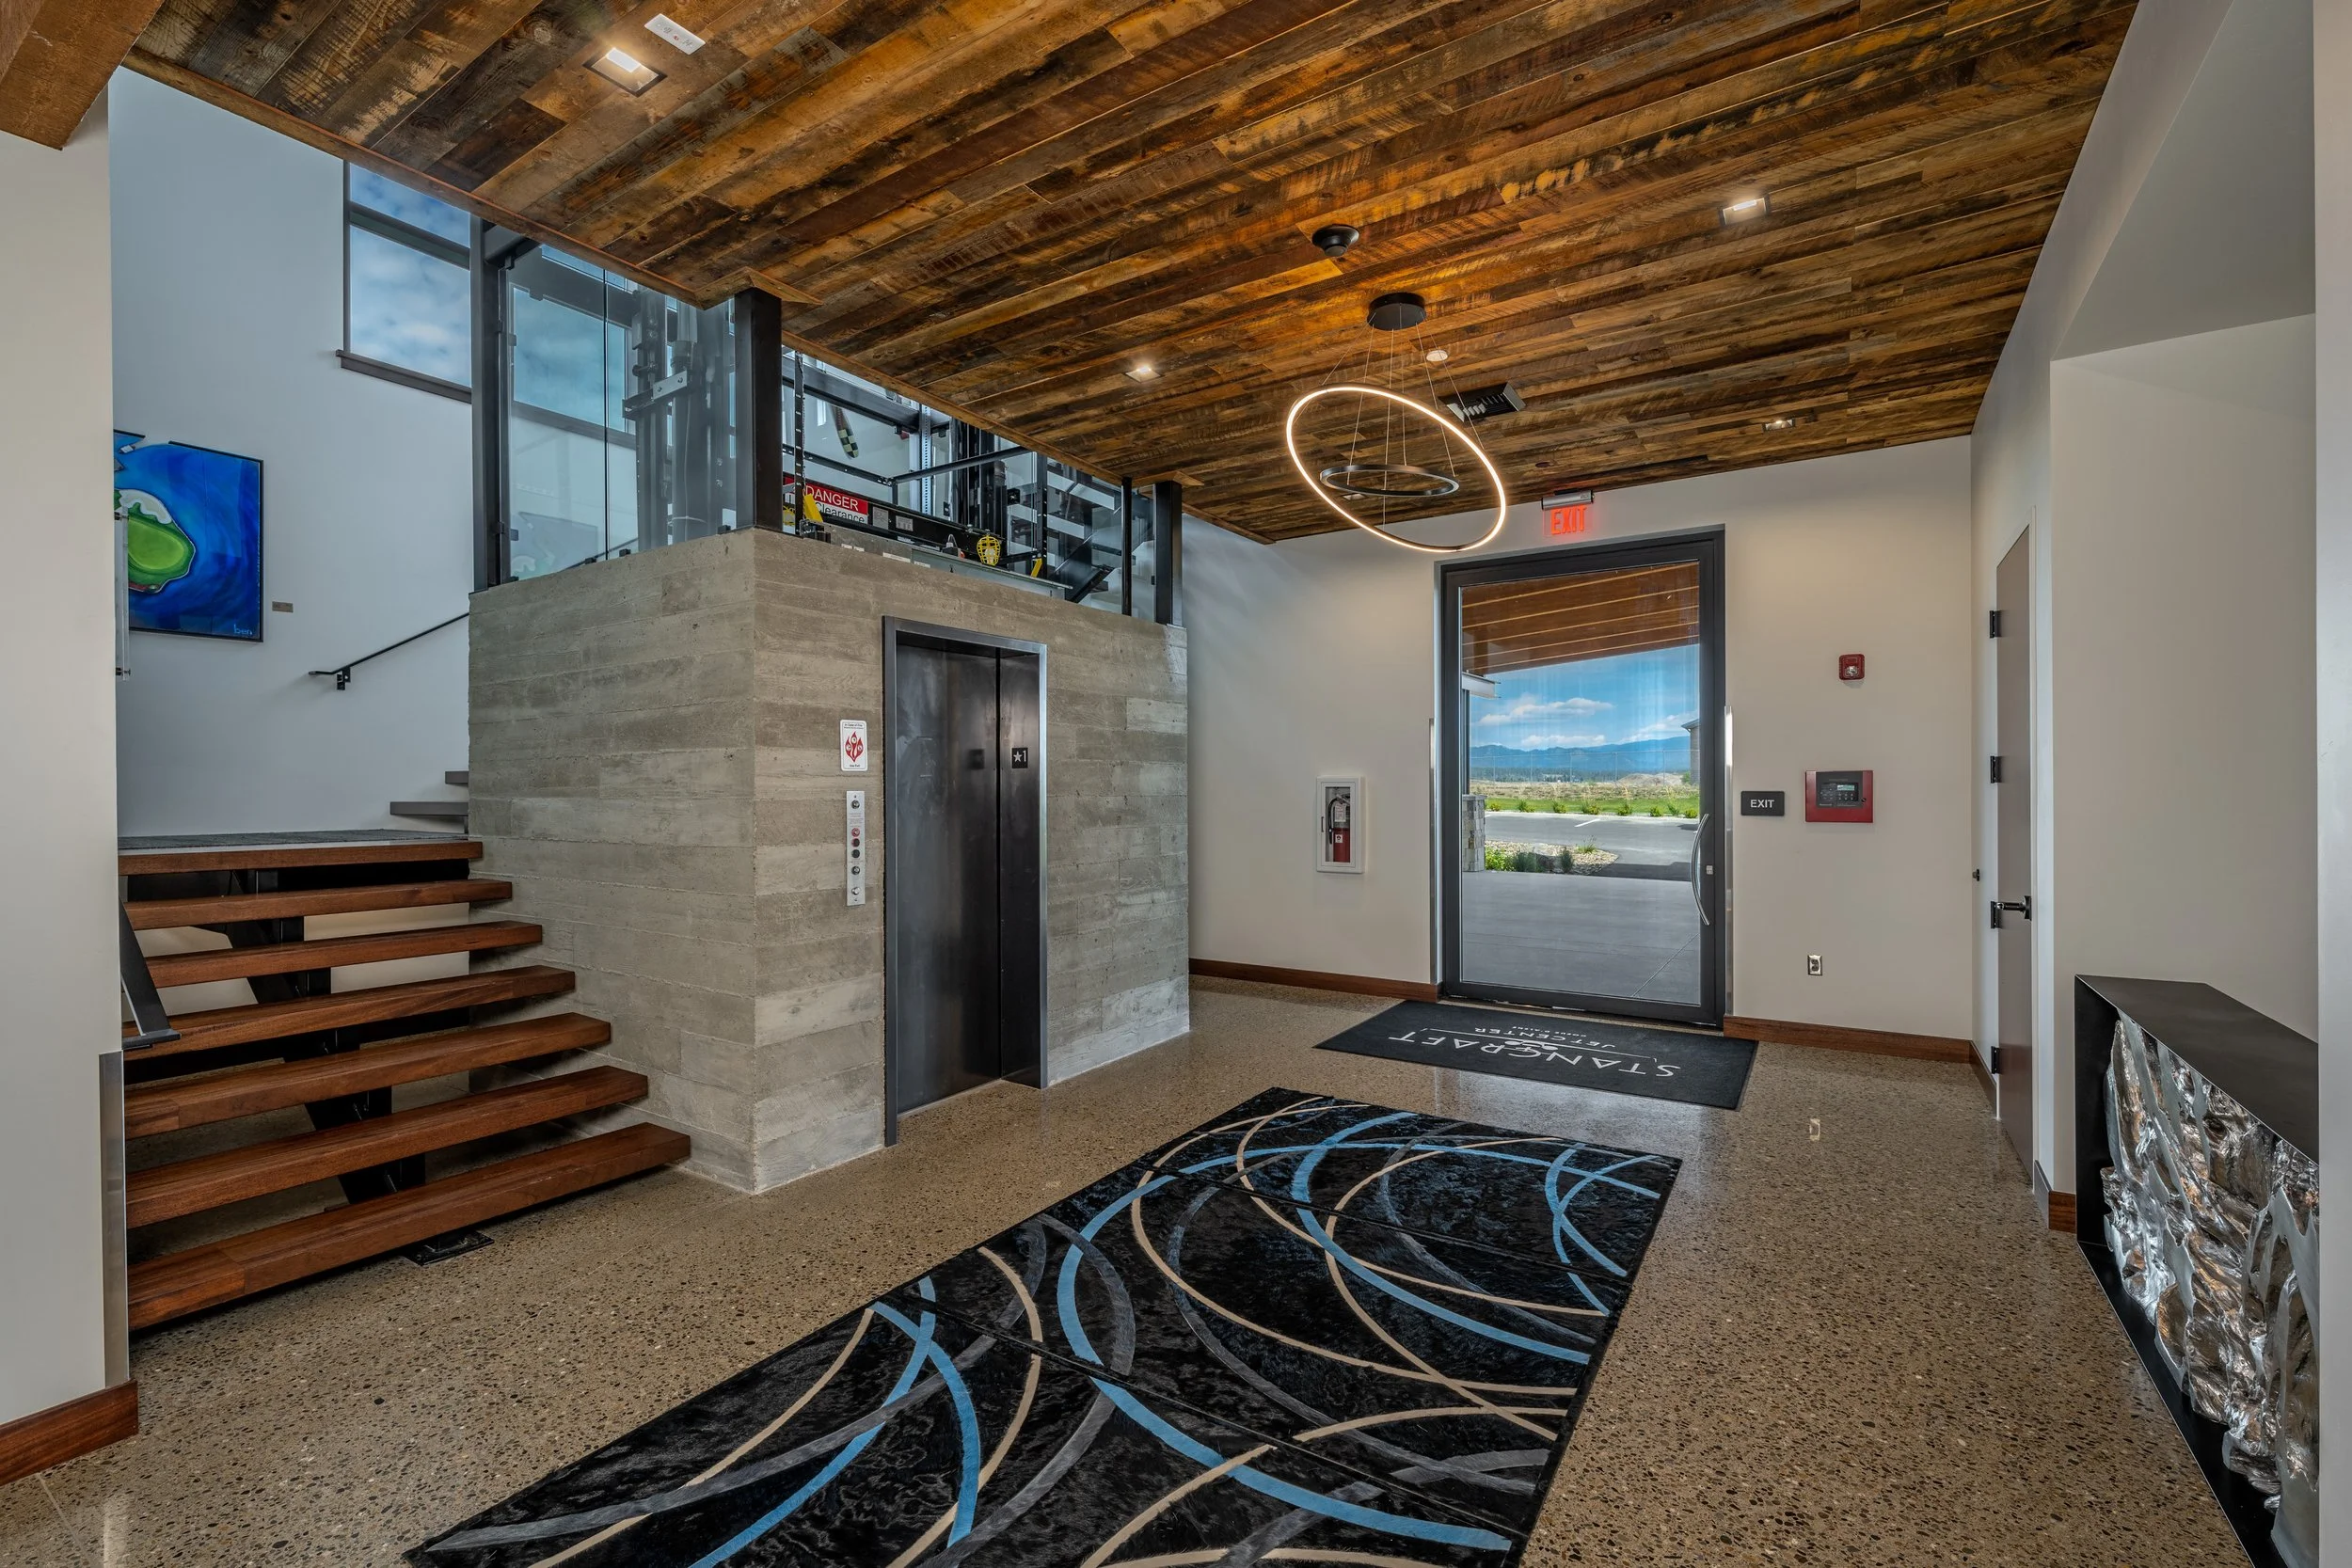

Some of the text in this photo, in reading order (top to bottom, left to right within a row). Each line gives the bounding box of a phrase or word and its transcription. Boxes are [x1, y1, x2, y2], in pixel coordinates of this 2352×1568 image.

[805, 484, 859, 512] DANGER
[1550, 504, 1587, 535] EXIT
[1022, 750, 1026, 763] 1
[1750, 799, 1775, 808] EXIT
[1388, 1031, 1681, 1077] STANCRAFT
